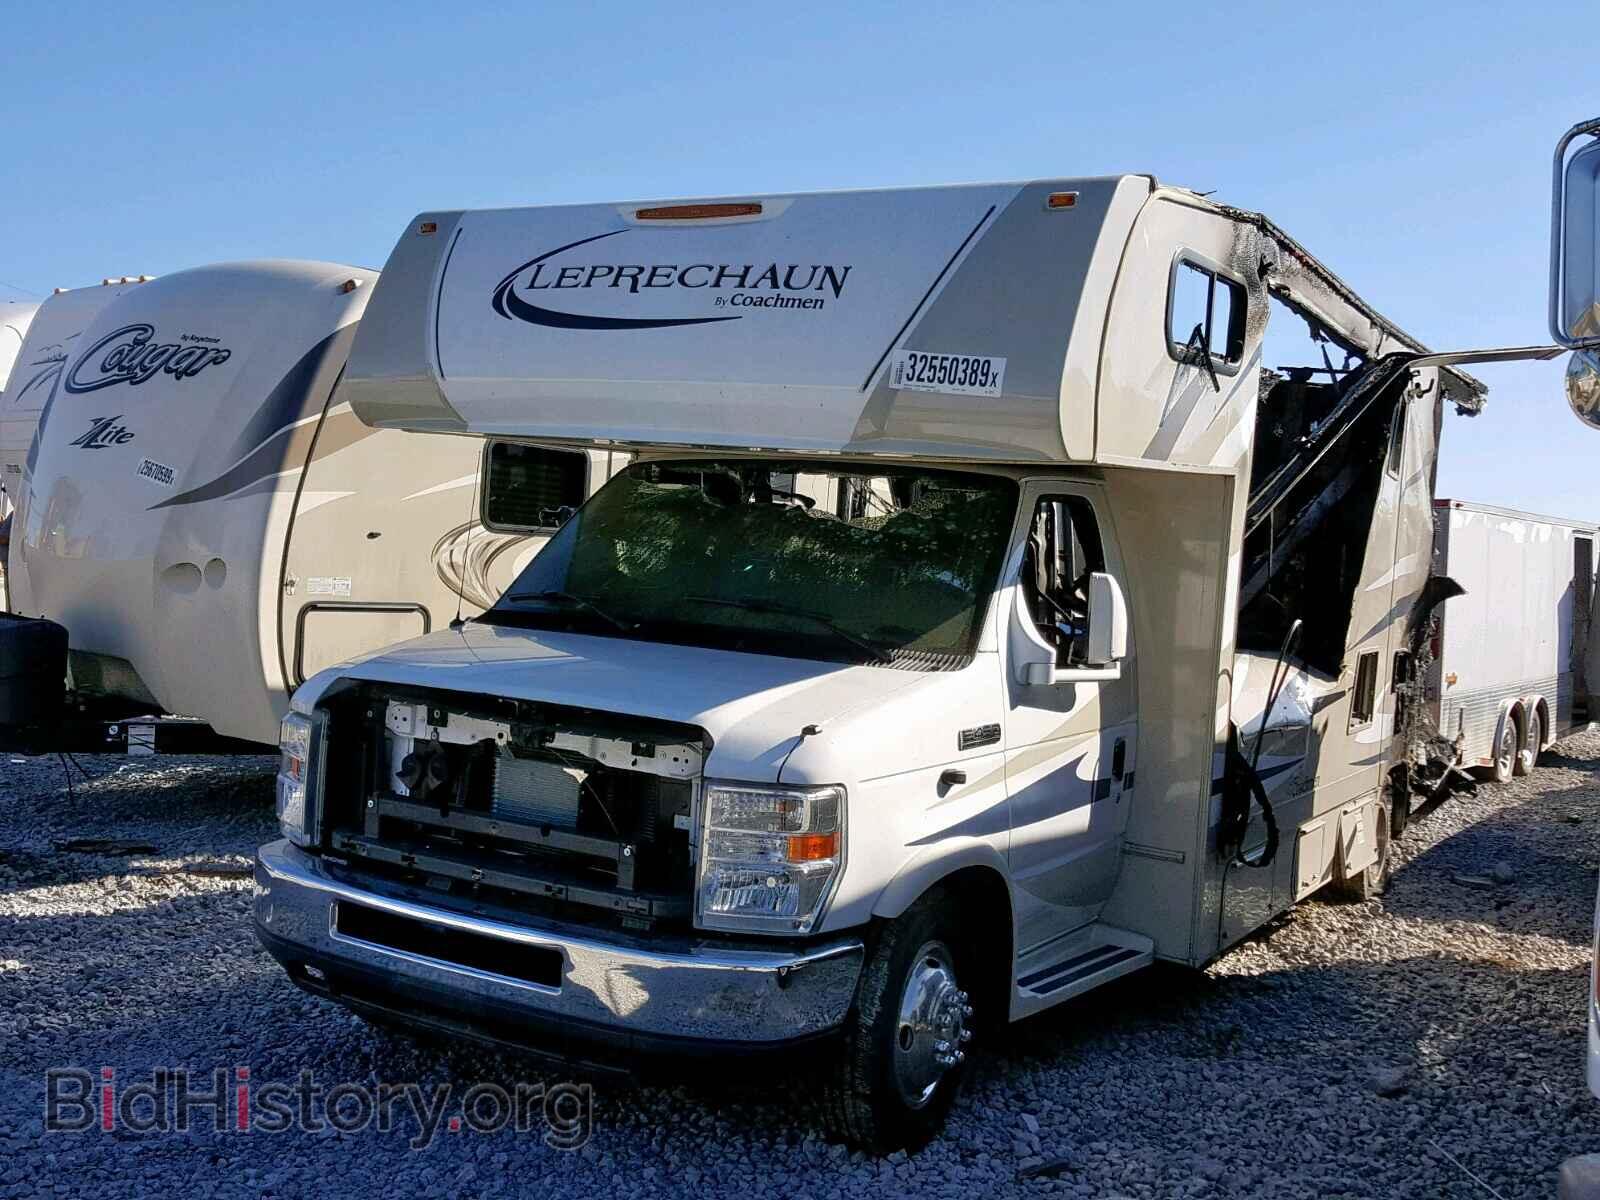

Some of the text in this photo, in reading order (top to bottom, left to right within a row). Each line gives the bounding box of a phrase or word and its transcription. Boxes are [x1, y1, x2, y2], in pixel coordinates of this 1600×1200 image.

[525, 263, 852, 299] LEPRECHAUN
[714, 293, 825, 310] By Coachmen
[65, 323, 231, 394] Cougar
